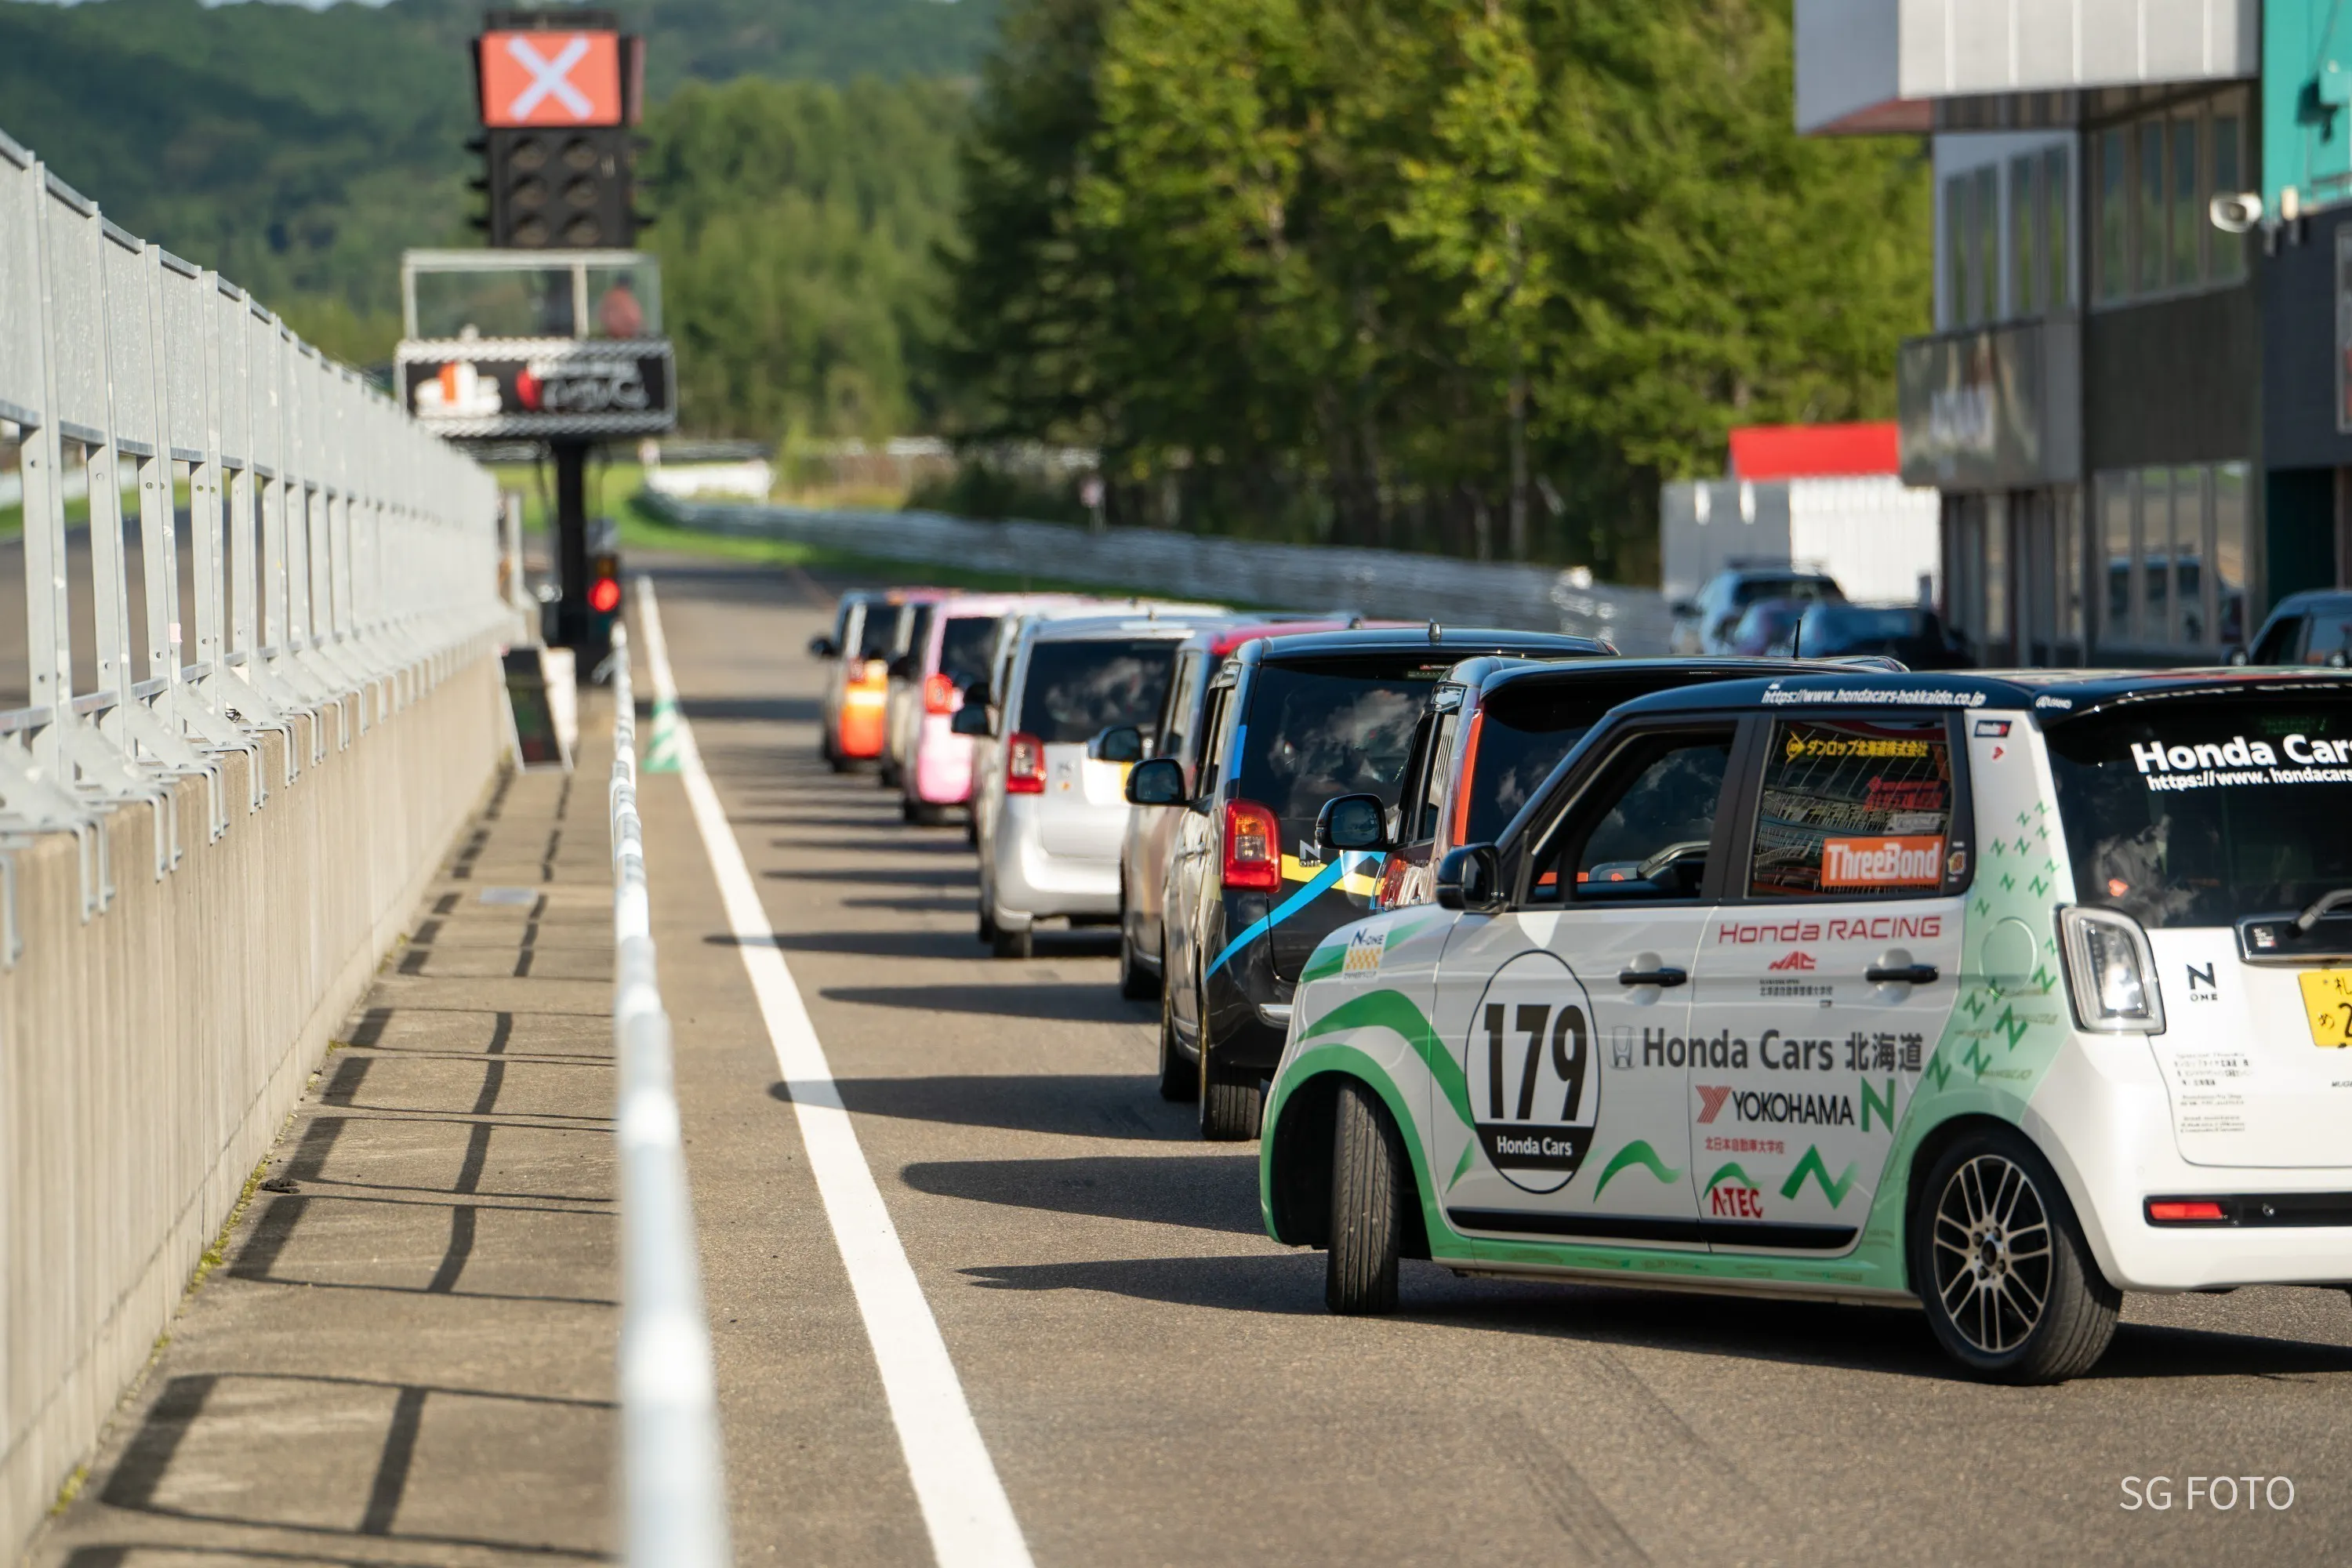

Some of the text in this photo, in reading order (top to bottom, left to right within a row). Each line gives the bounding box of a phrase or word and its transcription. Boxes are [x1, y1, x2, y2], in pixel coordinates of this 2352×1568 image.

[2131, 734, 2352, 774] Honda Car
[1827, 841, 1940, 880] ThreeBond
[1718, 916, 1941, 943] Honda RACING
[2186, 962, 2216, 989] N
[2190, 993, 2218, 1002] ONE
[1484, 1004, 1587, 1121] 179
[1642, 1027, 1923, 1073] Honda Cars 北海道
[1732, 1090, 1856, 1126] YOKOHAMA
[1496, 1136, 1573, 1156] Honda Cars
